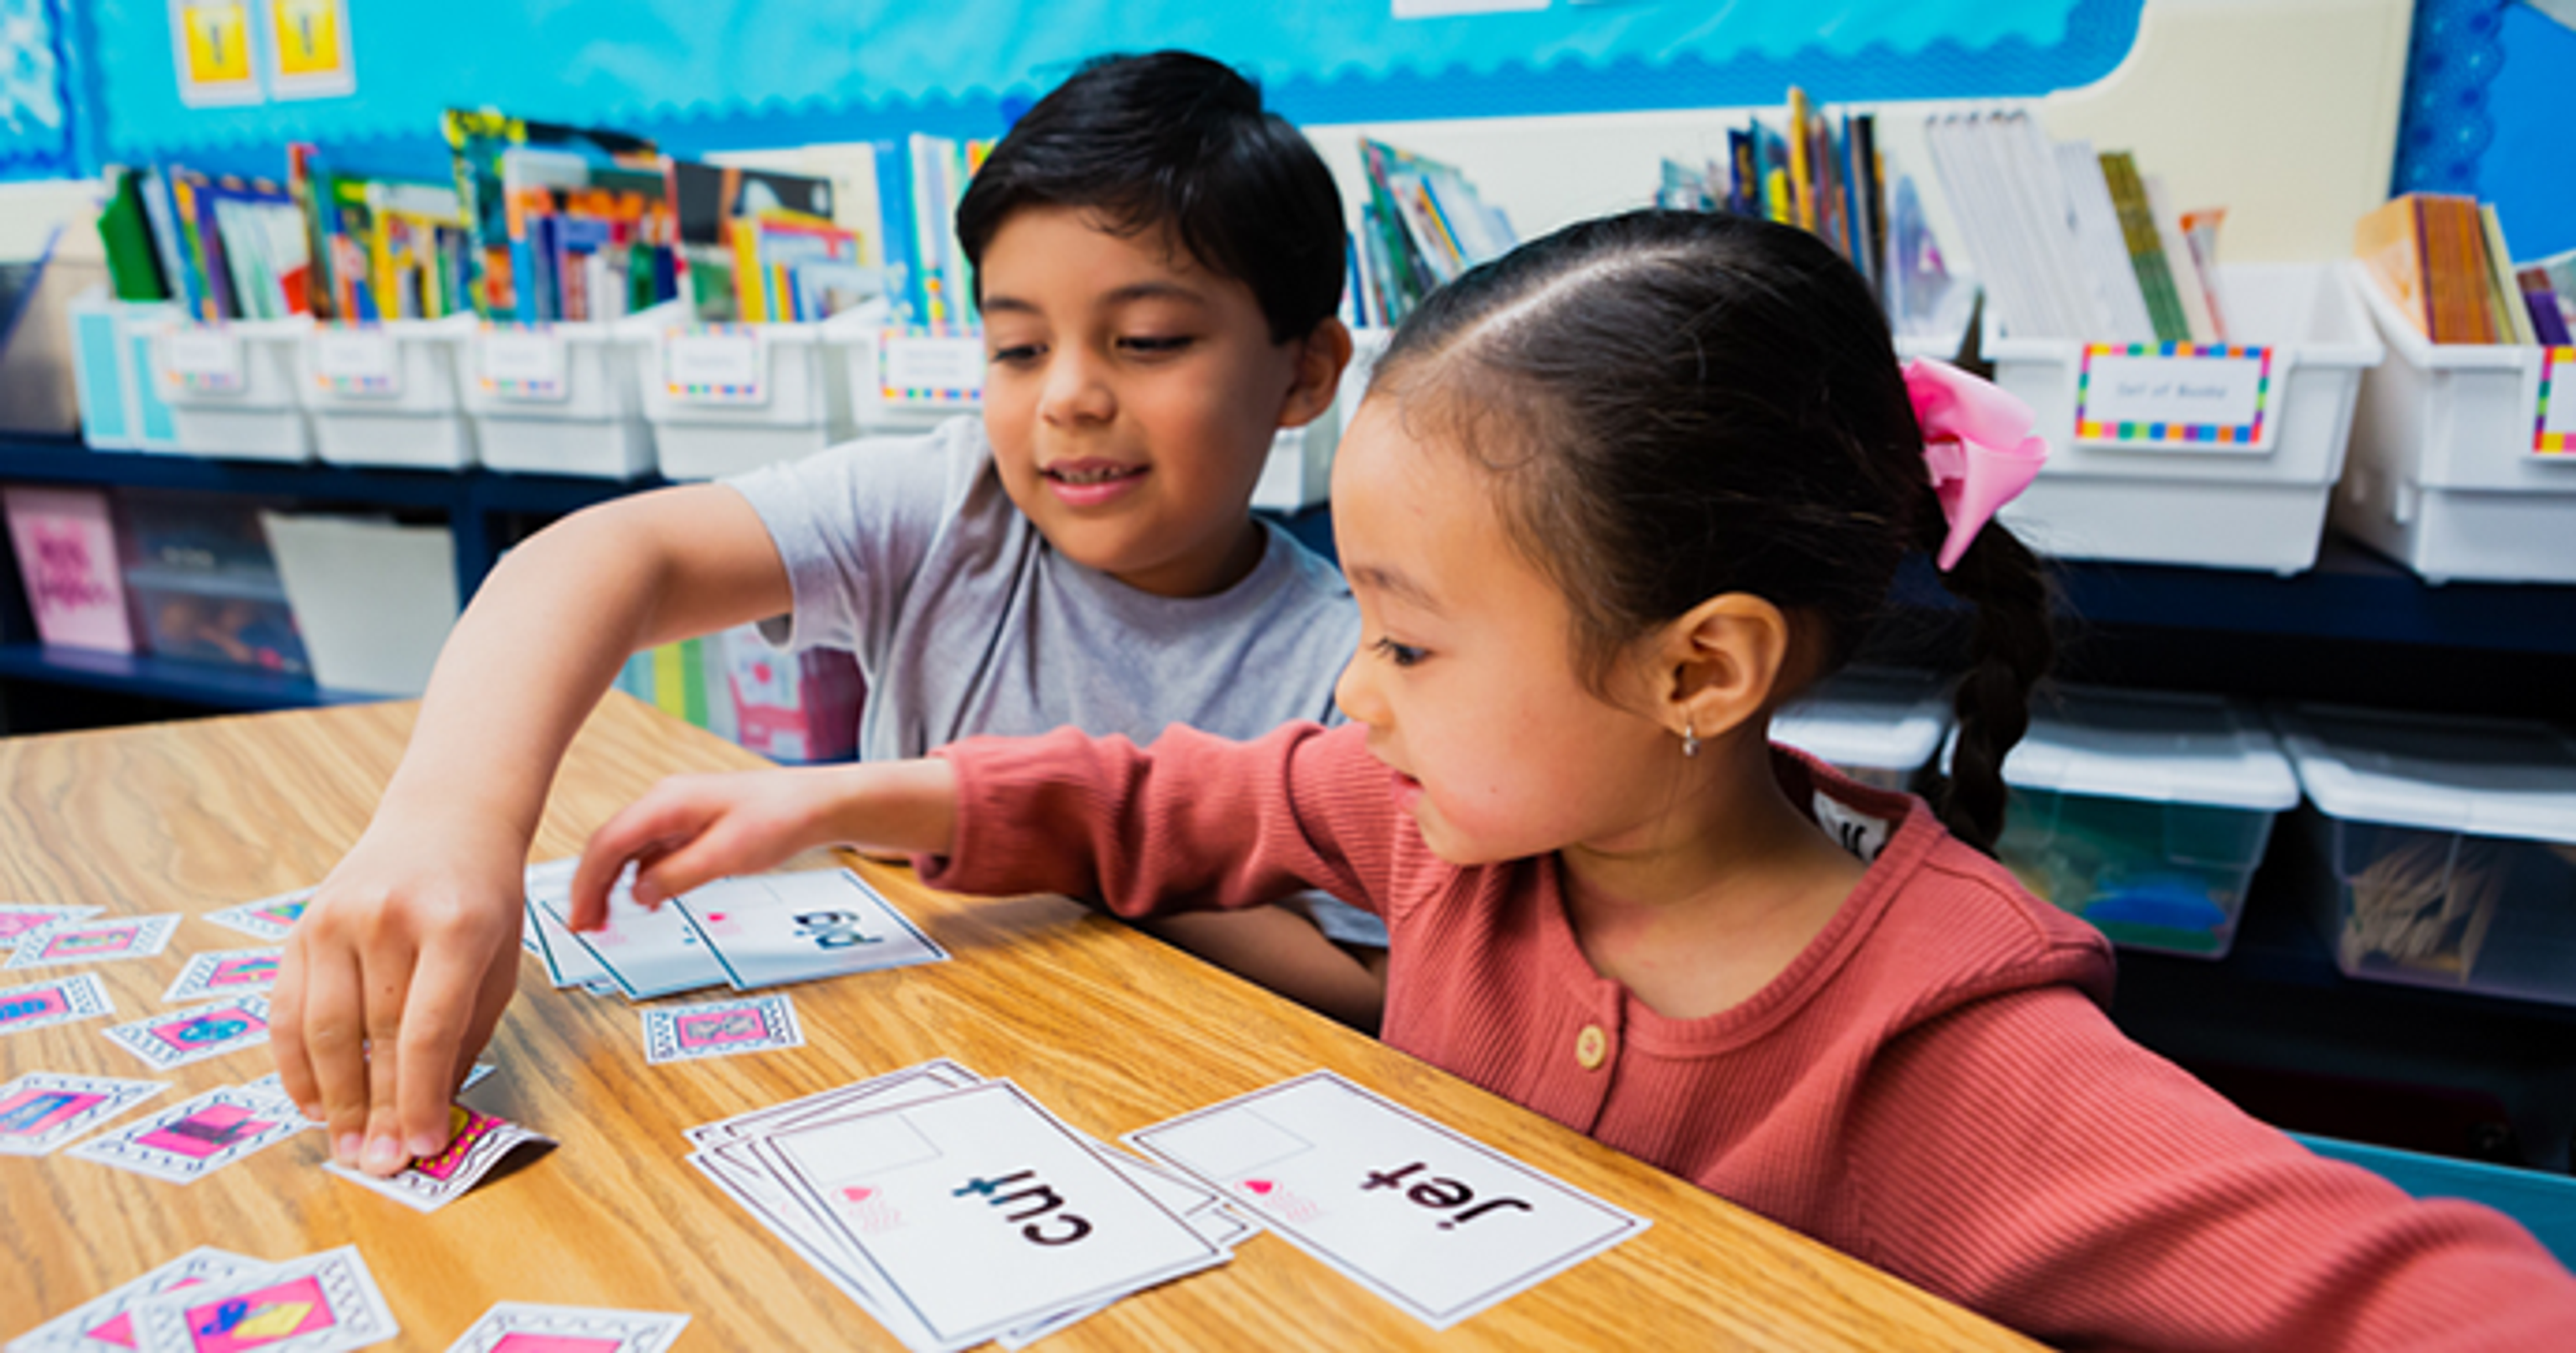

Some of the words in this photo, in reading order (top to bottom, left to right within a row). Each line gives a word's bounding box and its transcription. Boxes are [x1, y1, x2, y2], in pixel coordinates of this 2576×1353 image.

[792, 910, 885, 951] pig
[952, 1169, 1093, 1246] cut
[1360, 1161, 1534, 1230] jet
